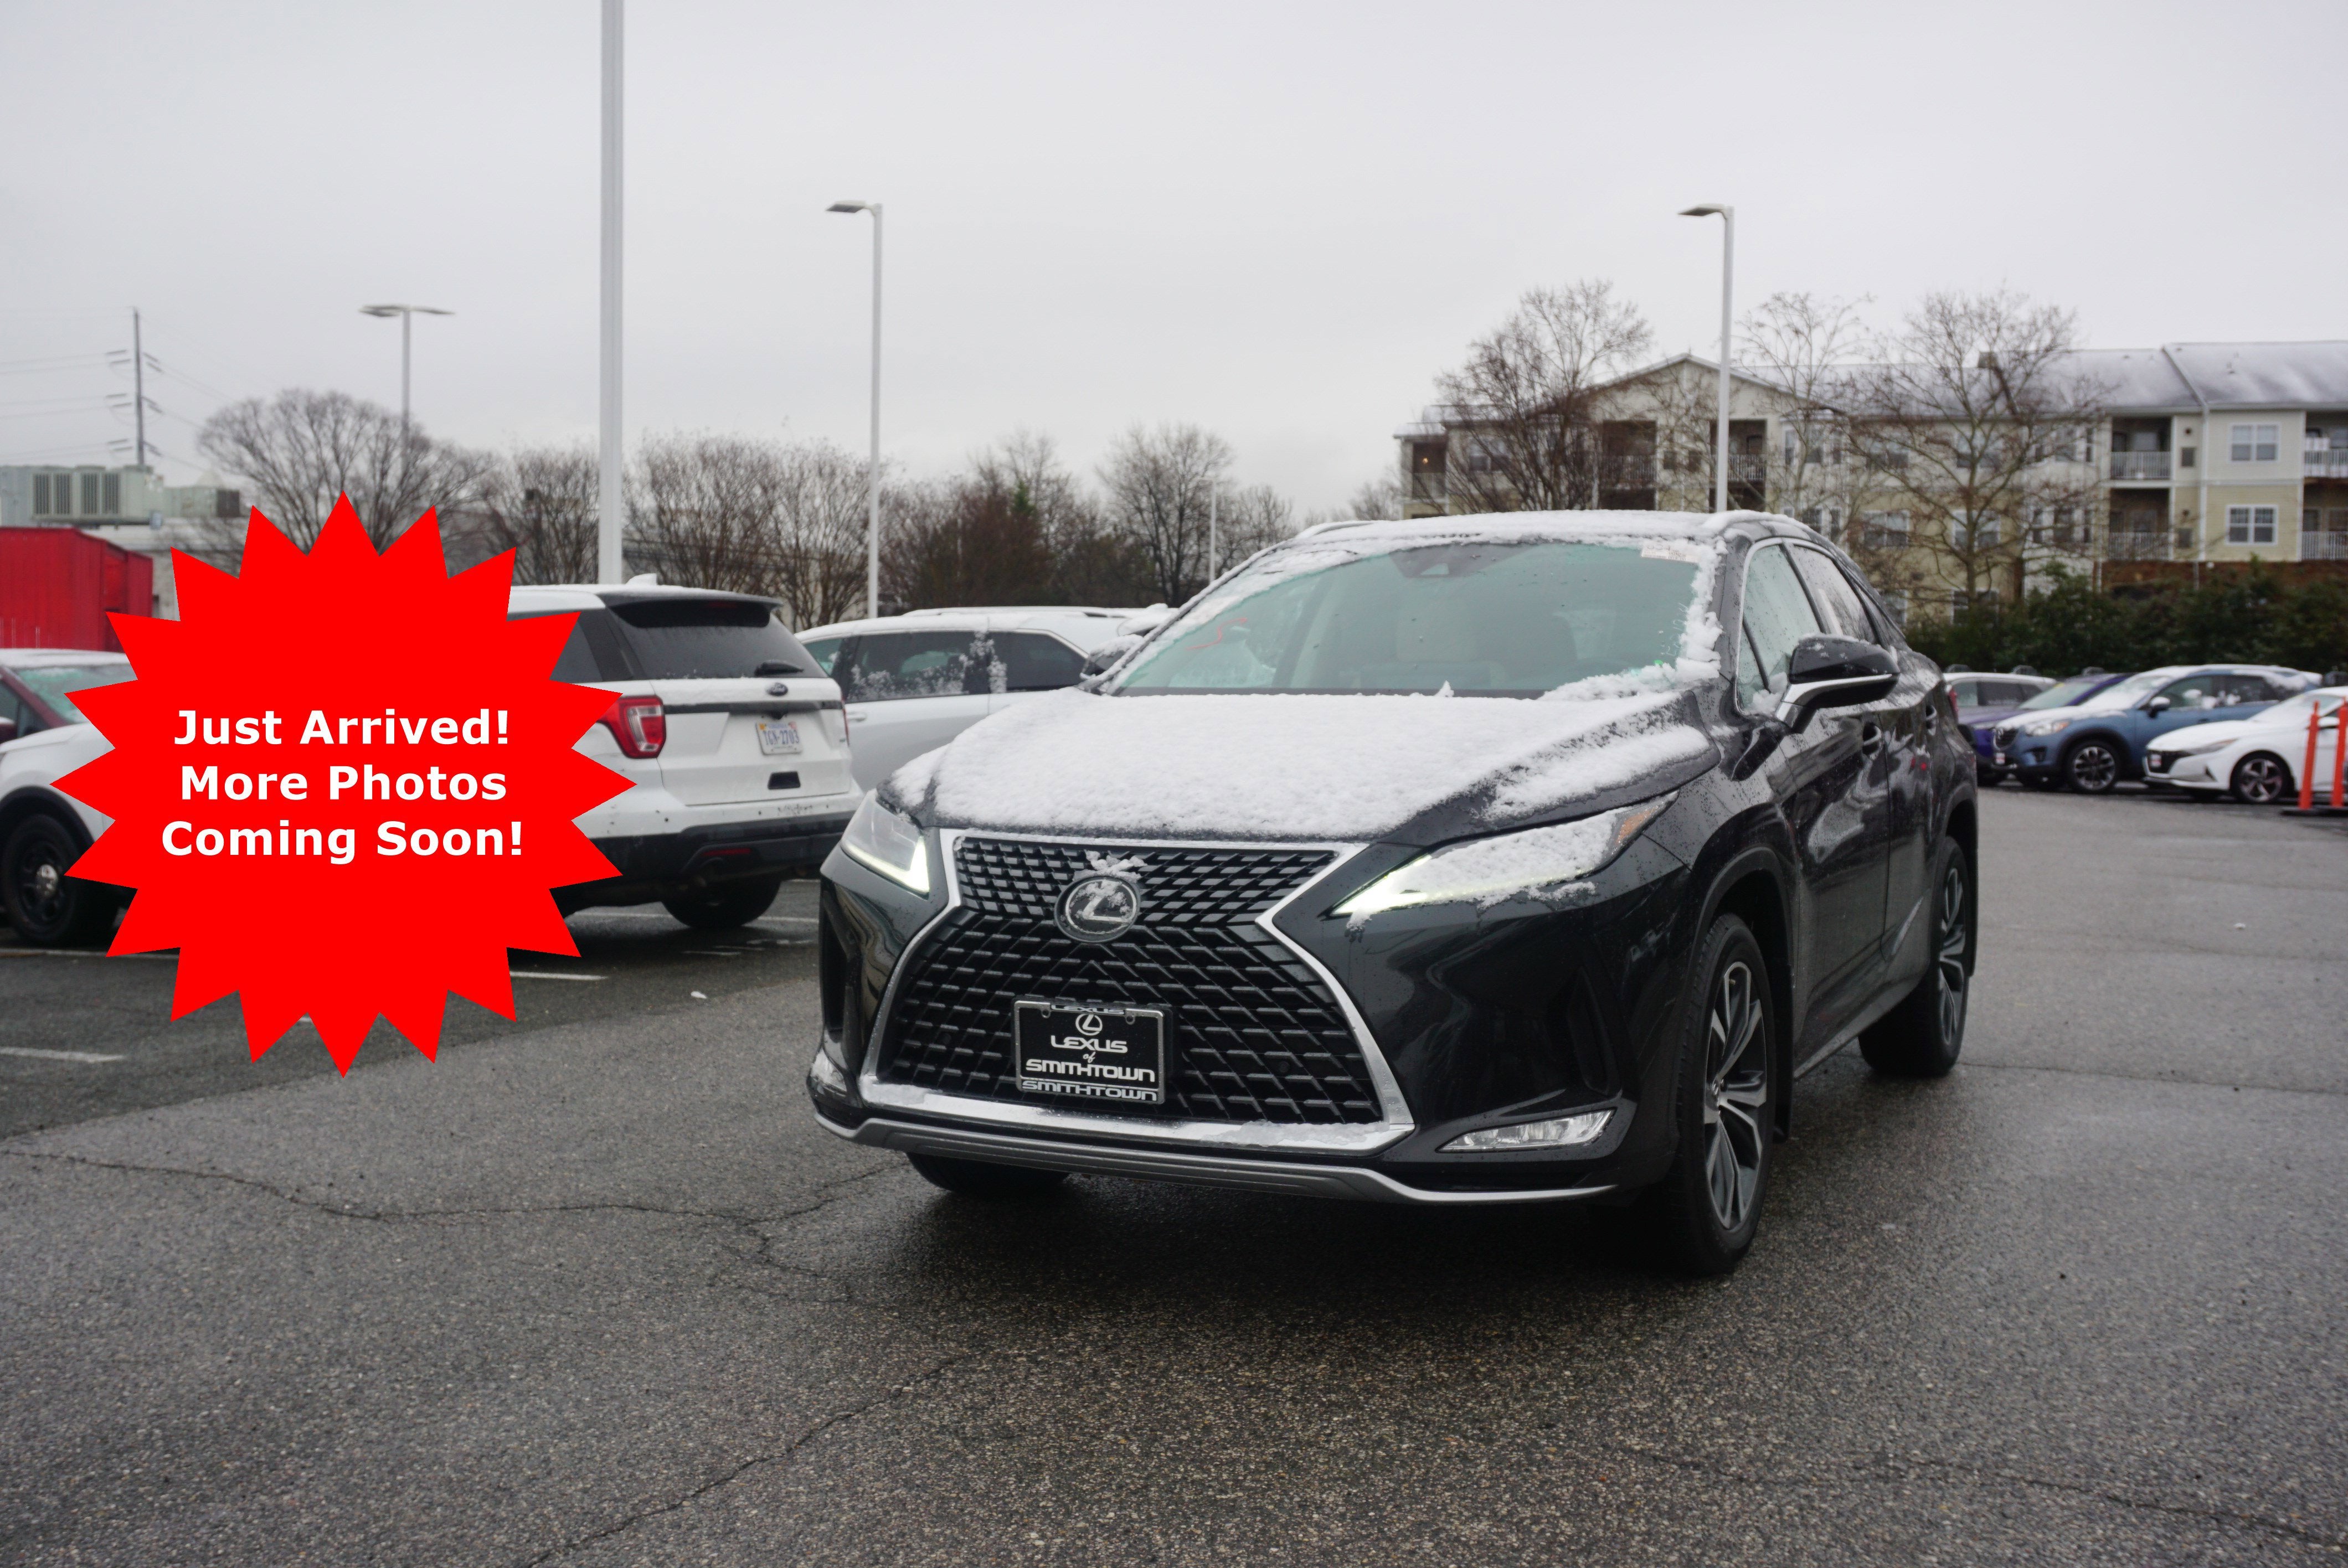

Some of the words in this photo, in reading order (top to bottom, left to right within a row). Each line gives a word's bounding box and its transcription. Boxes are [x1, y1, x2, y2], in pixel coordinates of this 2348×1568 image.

[1051, 1035, 1127, 1053] LEXUS
[1083, 1051, 1095, 1063] of
[1026, 1059, 1155, 1082] SMITHTOWN
[1022, 1080, 1157, 1101] SMITHTOWN
